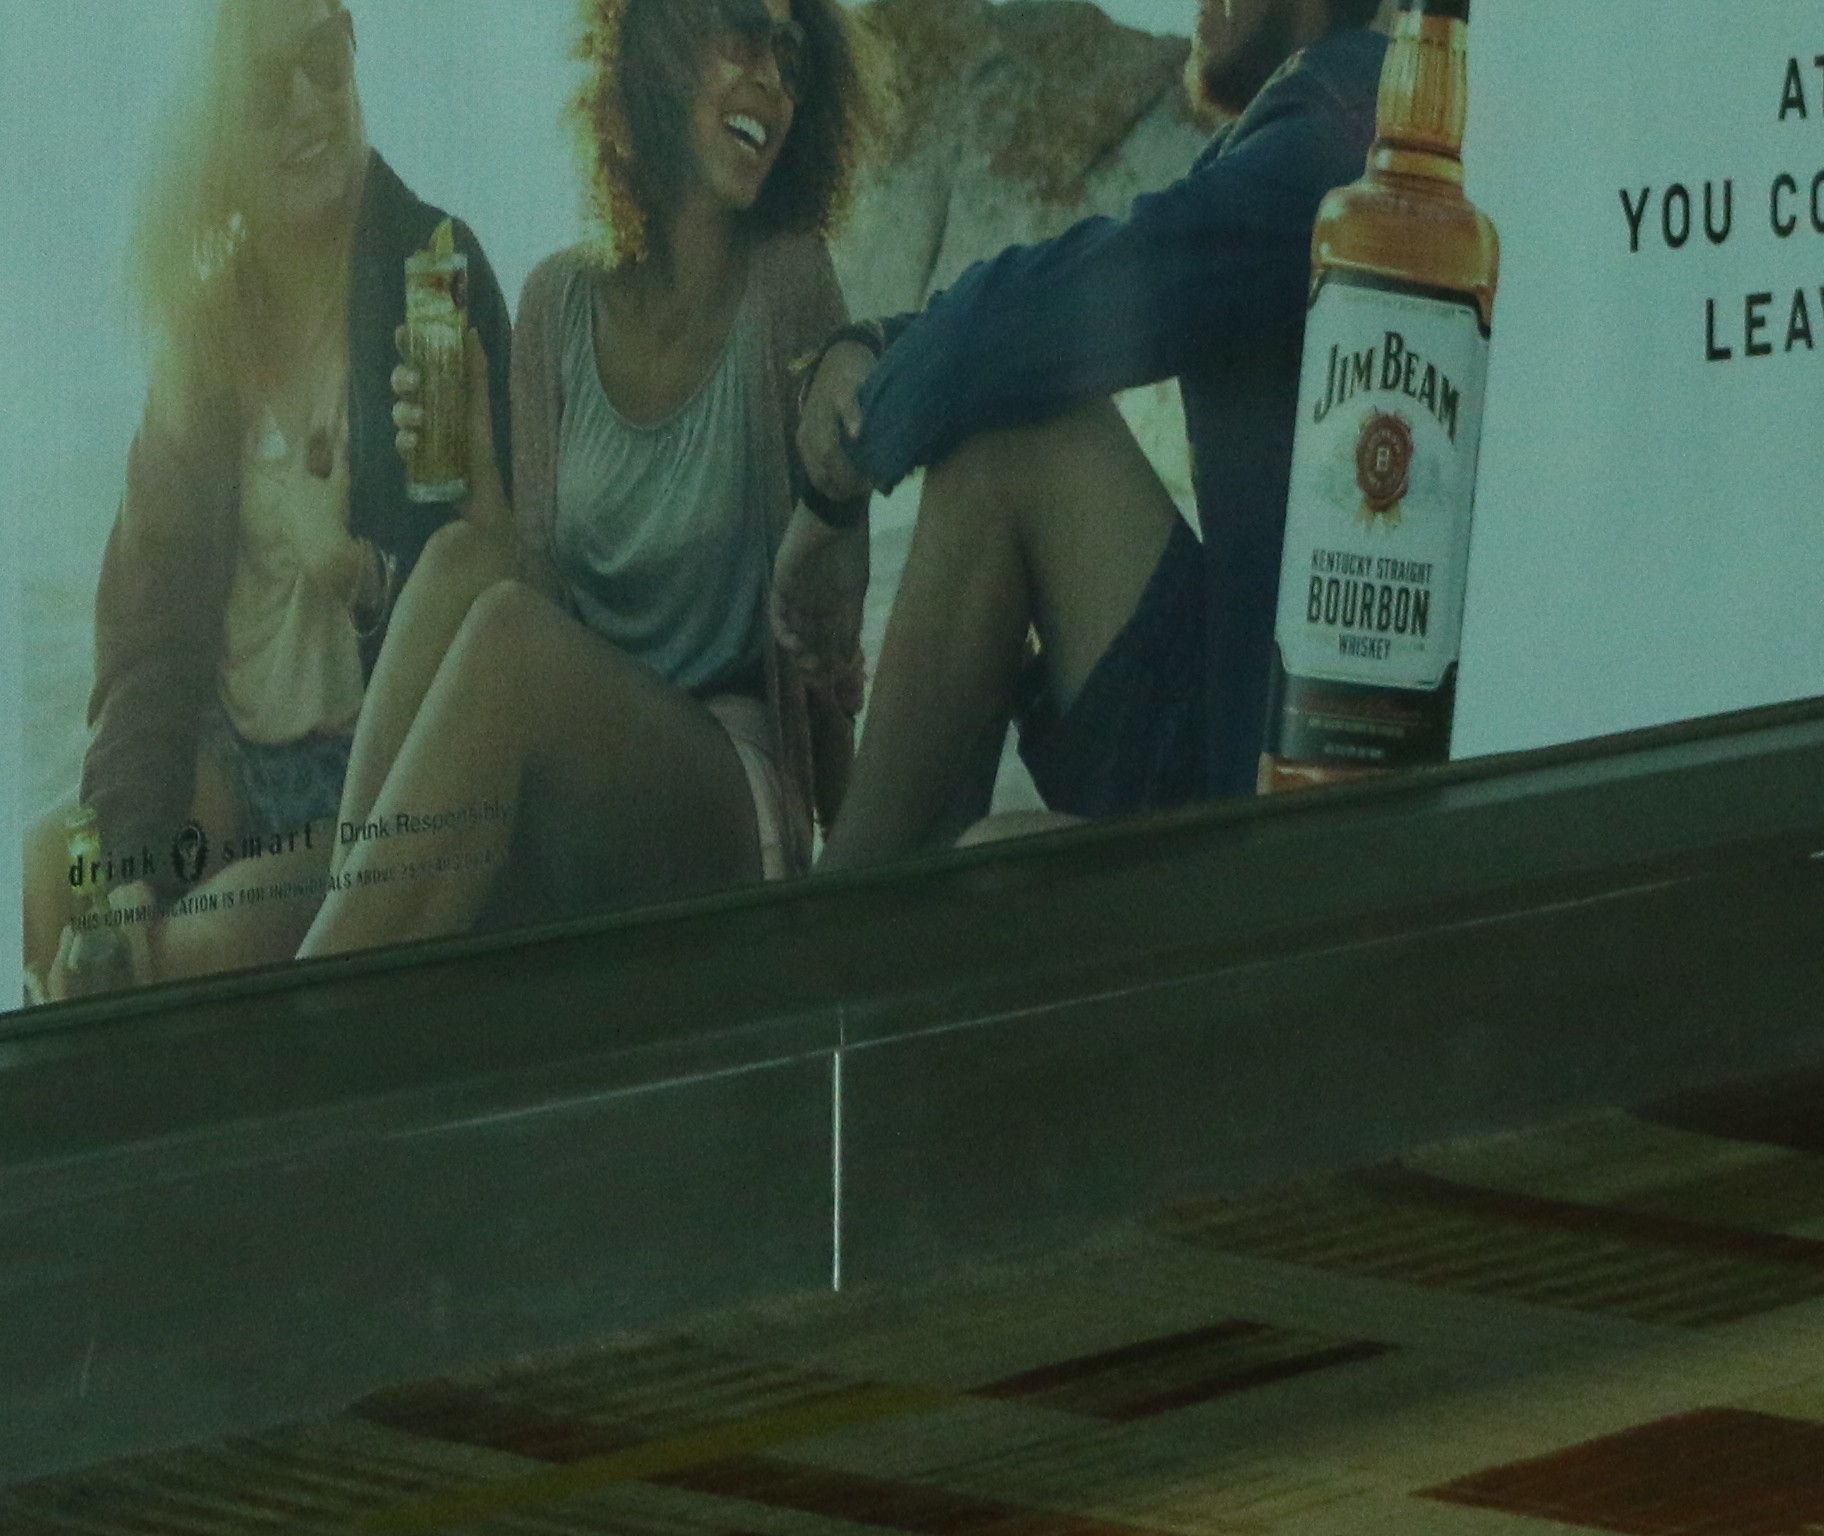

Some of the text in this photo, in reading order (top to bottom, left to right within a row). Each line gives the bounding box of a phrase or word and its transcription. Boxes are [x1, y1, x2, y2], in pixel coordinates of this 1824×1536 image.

[1618, 178, 1733, 253] YOU
[1313, 331, 1461, 443] JIM BEAM
[1307, 575, 1430, 637] BOURBON
[69, 844, 156, 888] drink
[340, 817, 390, 845] Drink
